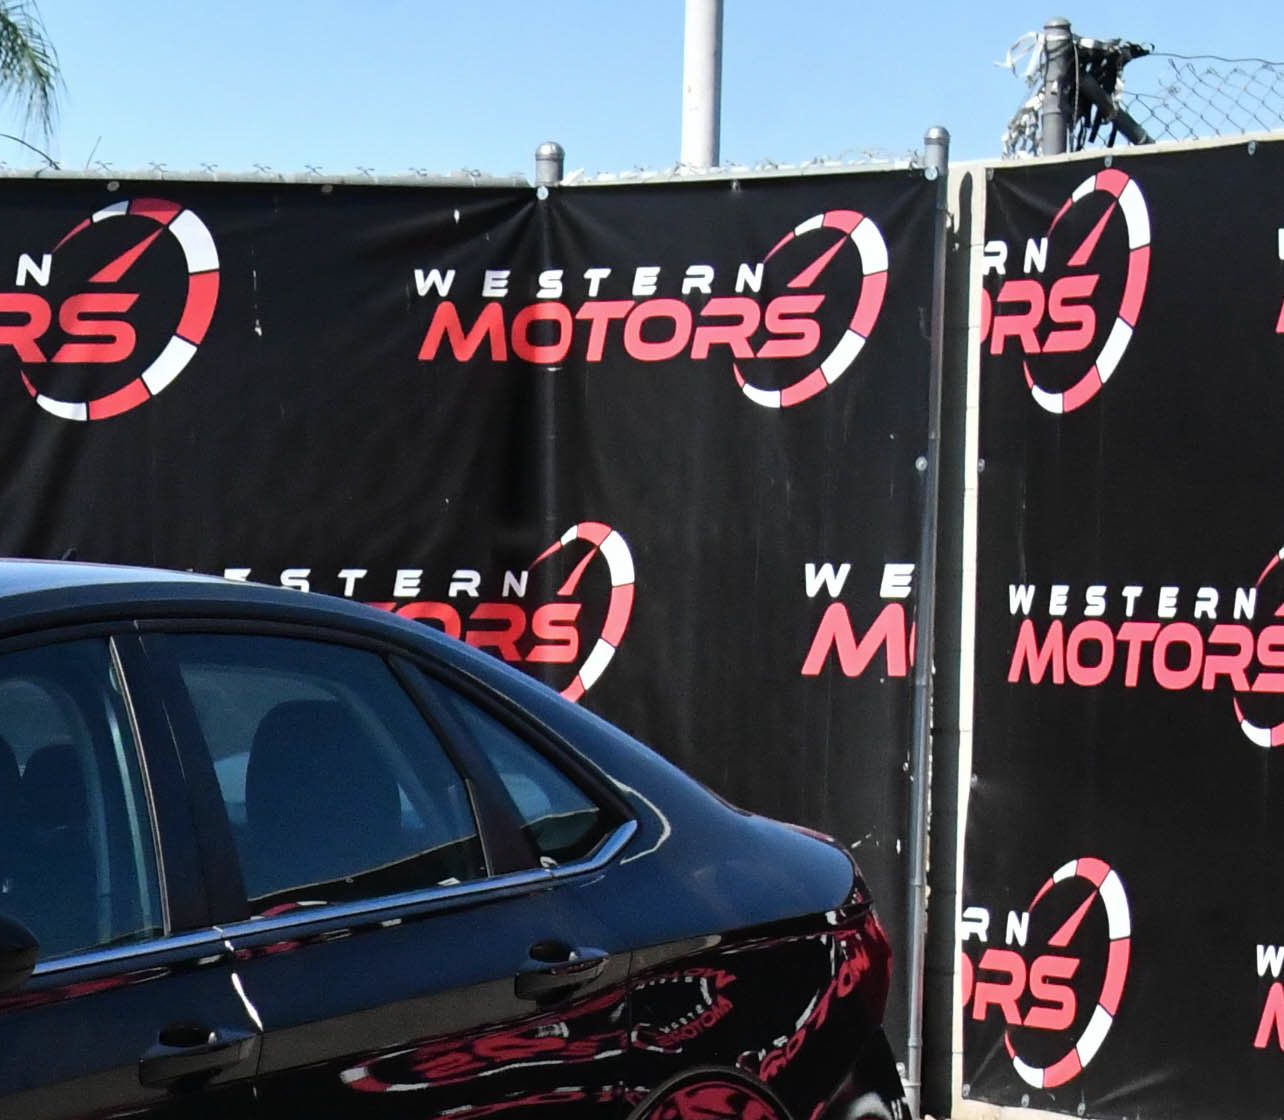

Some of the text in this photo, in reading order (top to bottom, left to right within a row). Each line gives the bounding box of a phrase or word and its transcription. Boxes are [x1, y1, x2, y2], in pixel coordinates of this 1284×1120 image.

[414, 262, 765, 297] WESTERN
[417, 293, 826, 363] MOTORS
[1008, 584, 1257, 620] WESTERN
